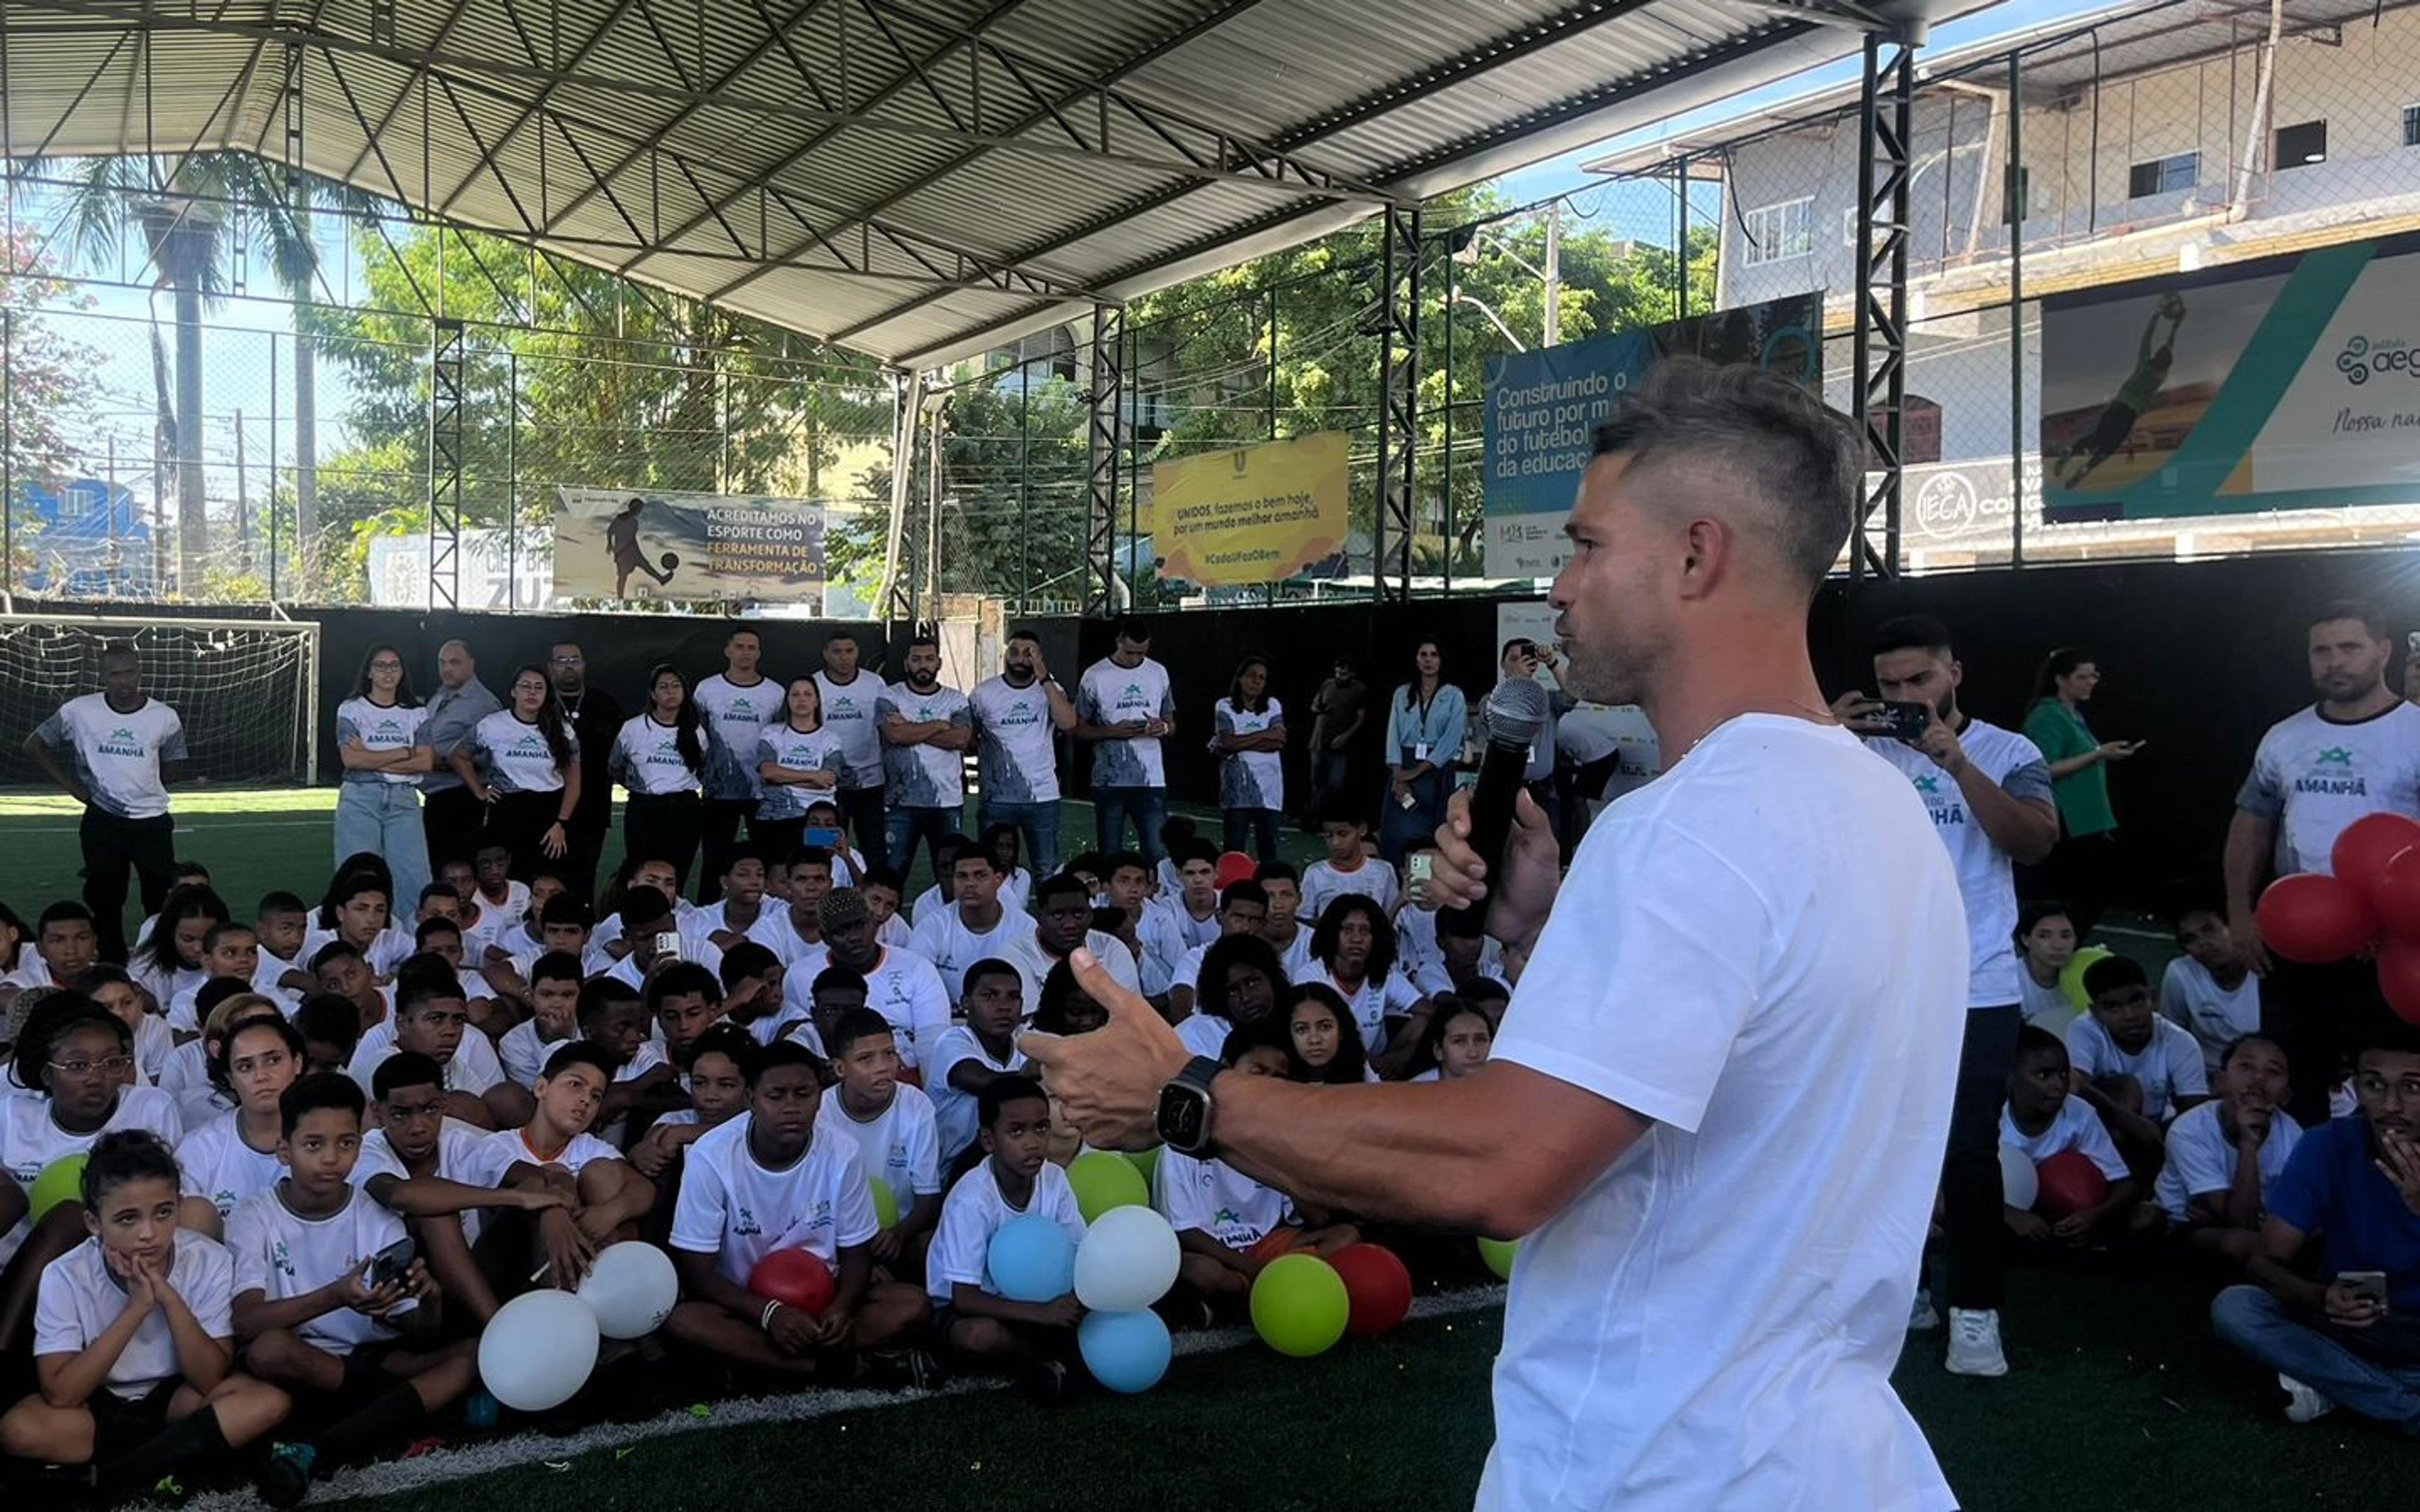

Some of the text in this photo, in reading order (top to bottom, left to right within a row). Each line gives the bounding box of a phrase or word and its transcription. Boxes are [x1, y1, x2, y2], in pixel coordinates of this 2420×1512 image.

[1496, 370, 1627, 410] Construindo o
[1497, 398, 1611, 433] futuro por m
[2332, 406, 2384, 433] Nossa
[1496, 420, 1589, 455] do futebol
[1496, 455, 1518, 478] da
[1214, 501, 1253, 514] fazemos
[1255, 500, 1261, 509] o
[1263, 496, 1286, 508] bem
[707, 508, 817, 526] ACREDITAMOS NO
[1173, 524, 1188, 537] por
[1189, 522, 1204, 534] um
[1204, 517, 1236, 532] mundo
[1238, 511, 1272, 529] melhor
[706, 525, 802, 542] ESPORTE COMO
[706, 542, 807, 558] FERRAMENTA DE
[708, 558, 817, 575] TRANSFORMAÇÃO
[2295, 777, 2366, 796] AMANHÃ
